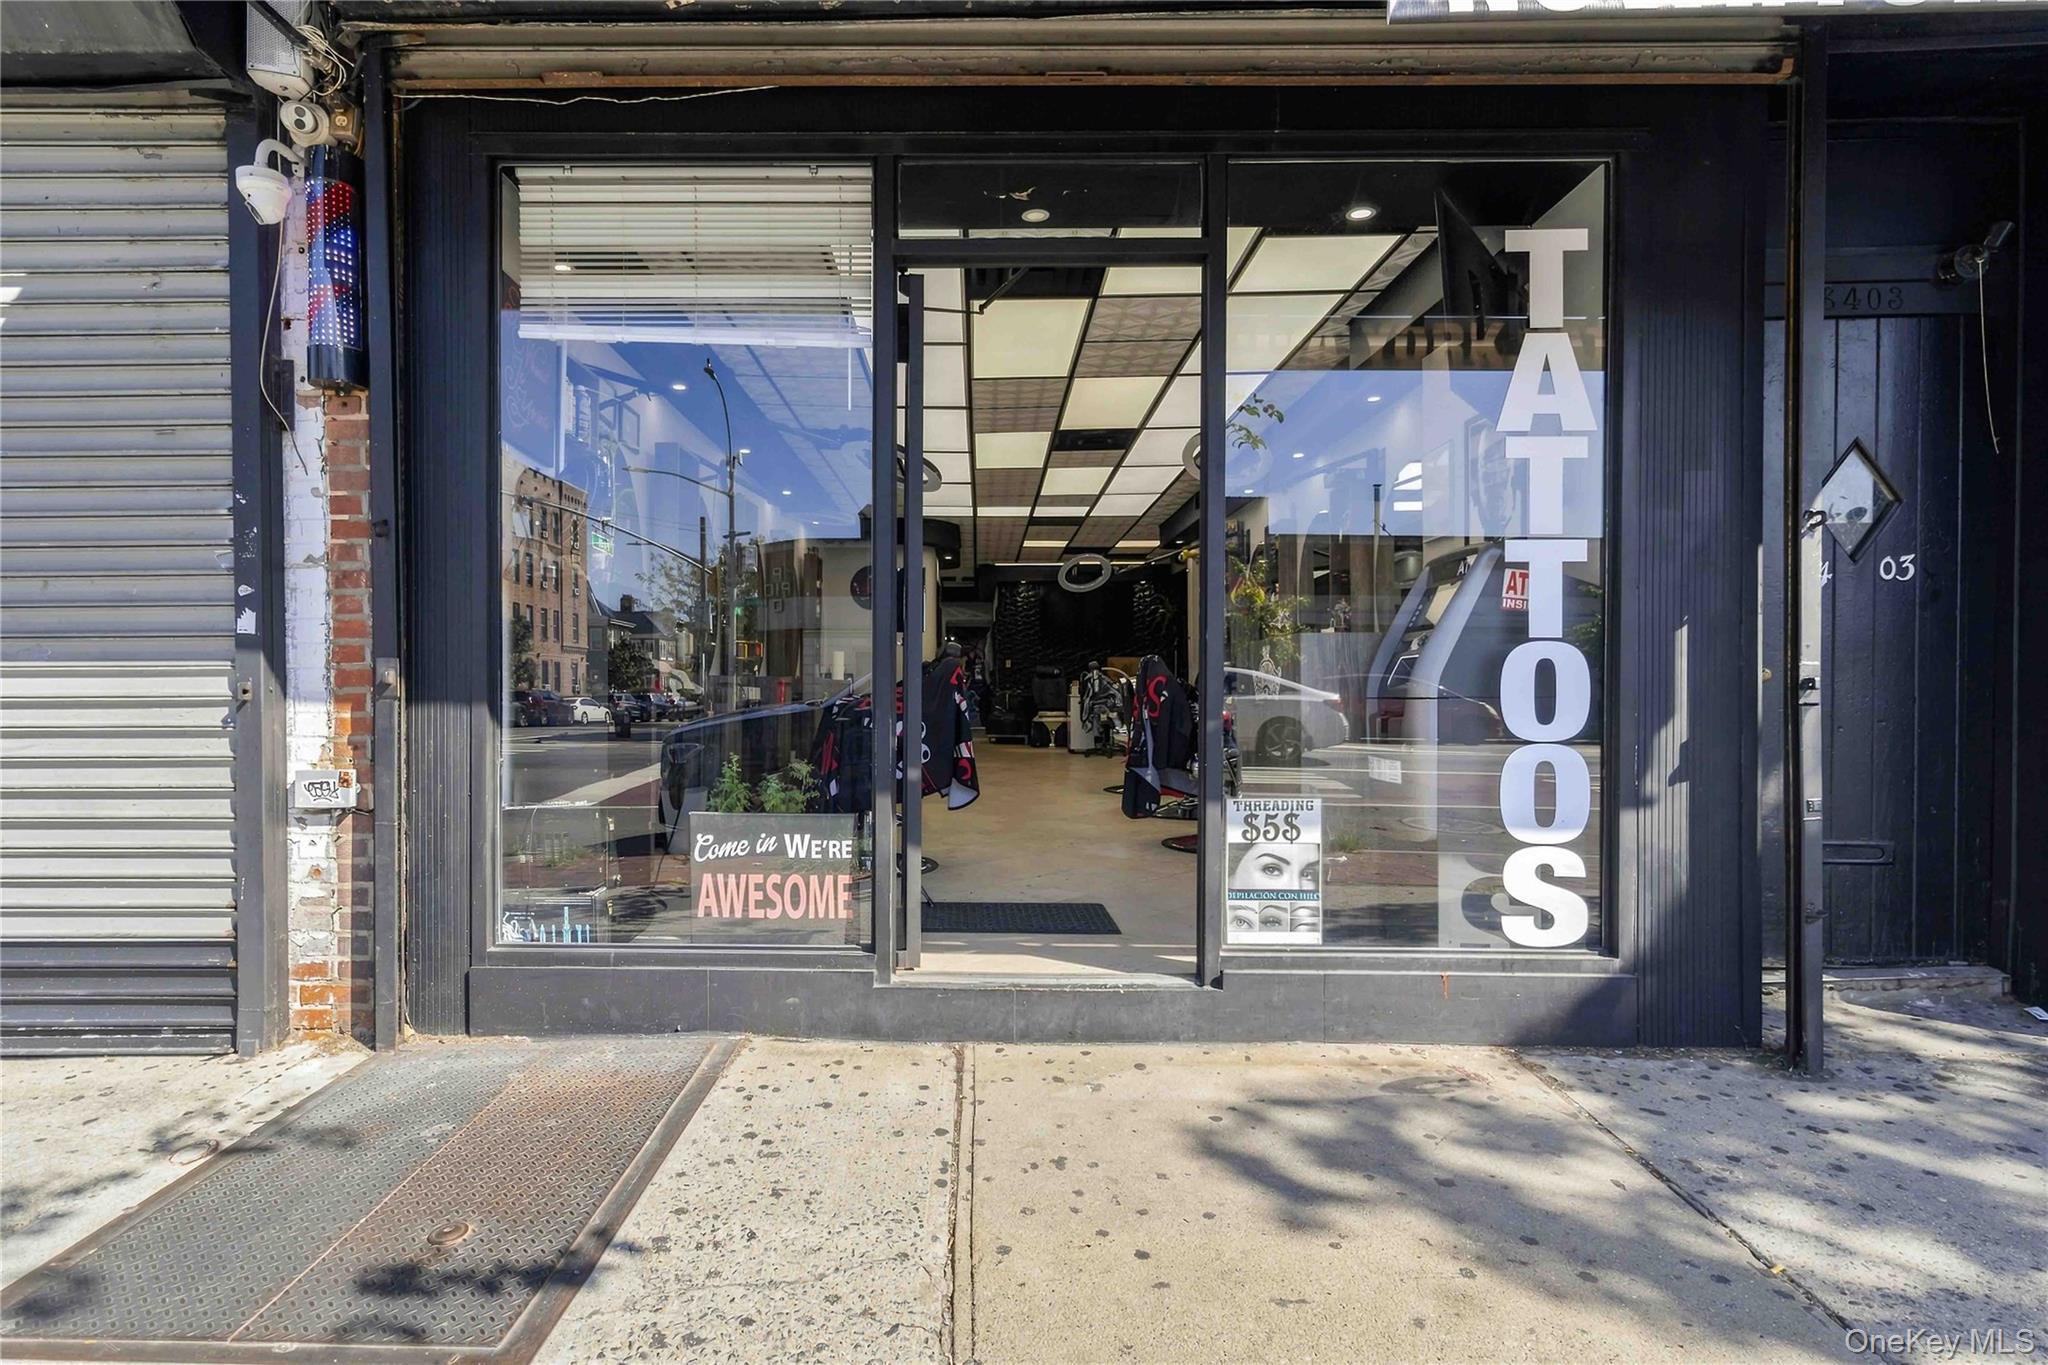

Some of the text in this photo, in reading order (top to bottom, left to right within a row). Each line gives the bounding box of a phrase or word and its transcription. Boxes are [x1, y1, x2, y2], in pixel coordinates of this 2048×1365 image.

[1879, 553, 1916, 581] 03
[1496, 228, 1598, 948] TATTOOS
[1505, 570, 1529, 597] AT
[1502, 598, 1527, 610] INSI
[1233, 800, 1315, 812] THREADING
[1241, 809, 1302, 845] $5$
[694, 833, 751, 862] Come
[756, 832, 778, 854] in
[697, 873, 854, 920] AWESOME
[1278, 892, 1298, 900] CON
